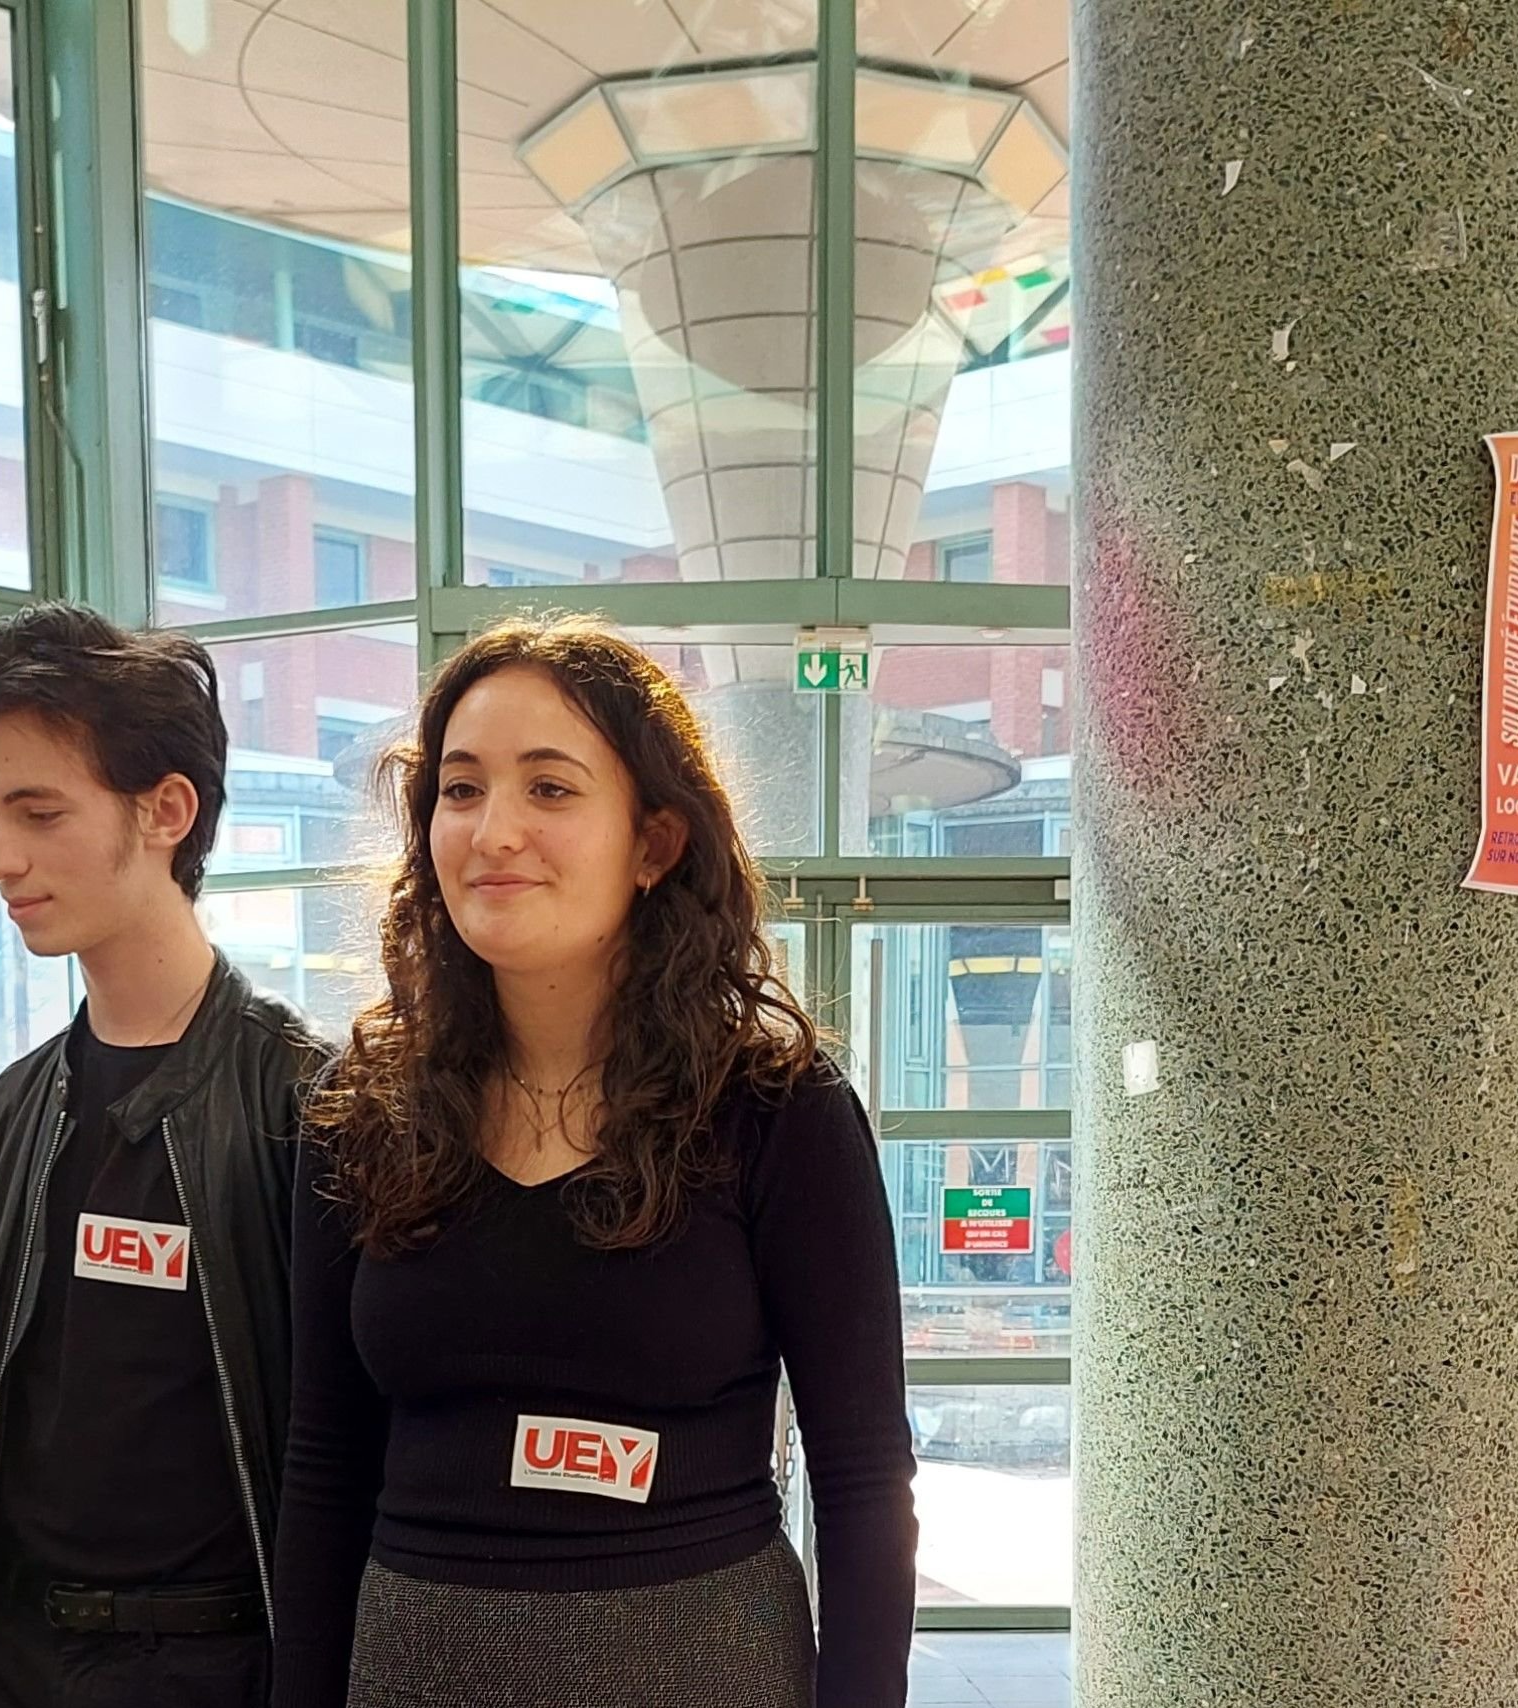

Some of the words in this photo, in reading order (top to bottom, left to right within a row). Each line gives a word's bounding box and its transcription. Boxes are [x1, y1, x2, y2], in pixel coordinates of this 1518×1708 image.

[1487, 849, 1506, 862] SUR
[981, 1199, 993, 1207] DE
[84, 1224, 184, 1278] UEY
[525, 1428, 653, 1489] UEY
